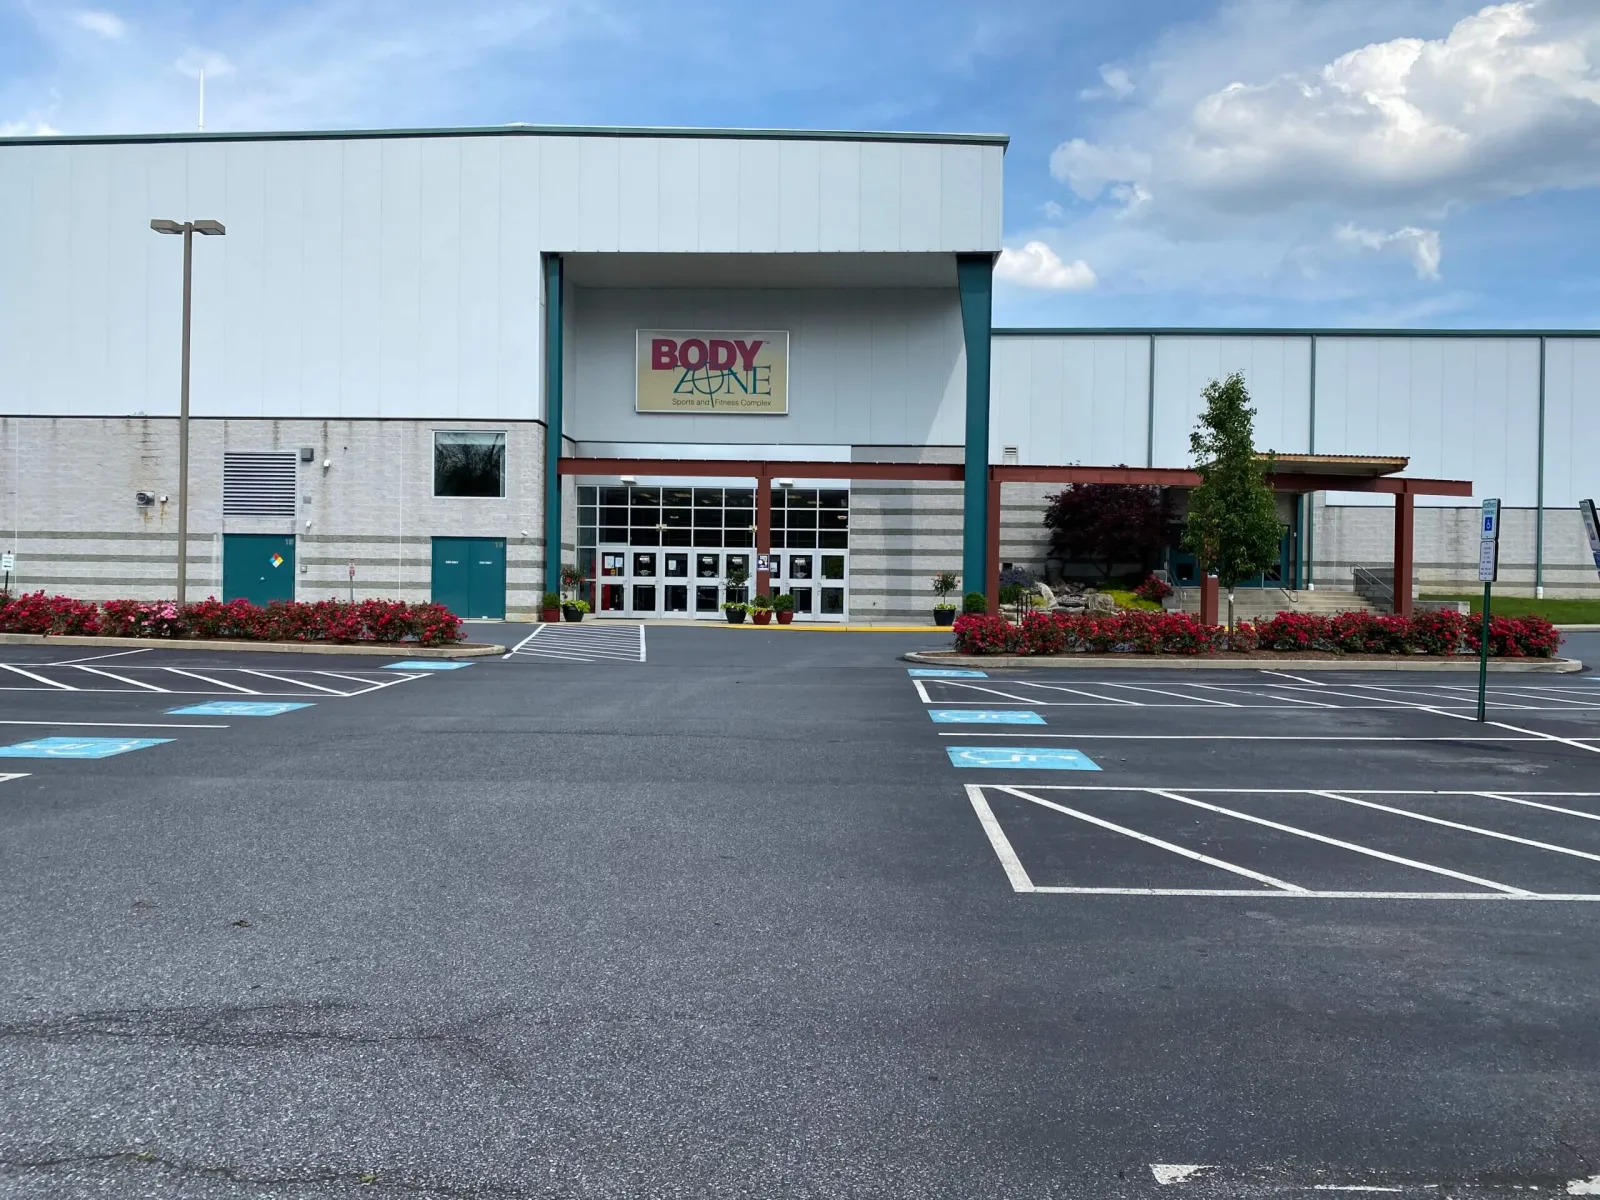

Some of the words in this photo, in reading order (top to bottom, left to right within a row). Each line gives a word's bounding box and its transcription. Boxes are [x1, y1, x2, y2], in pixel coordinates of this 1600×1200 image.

[652, 338, 763, 371] BODY
[672, 365, 771, 396] ZONE
[672, 398, 694, 406] Sports
[741, 399, 771, 407] Complex
